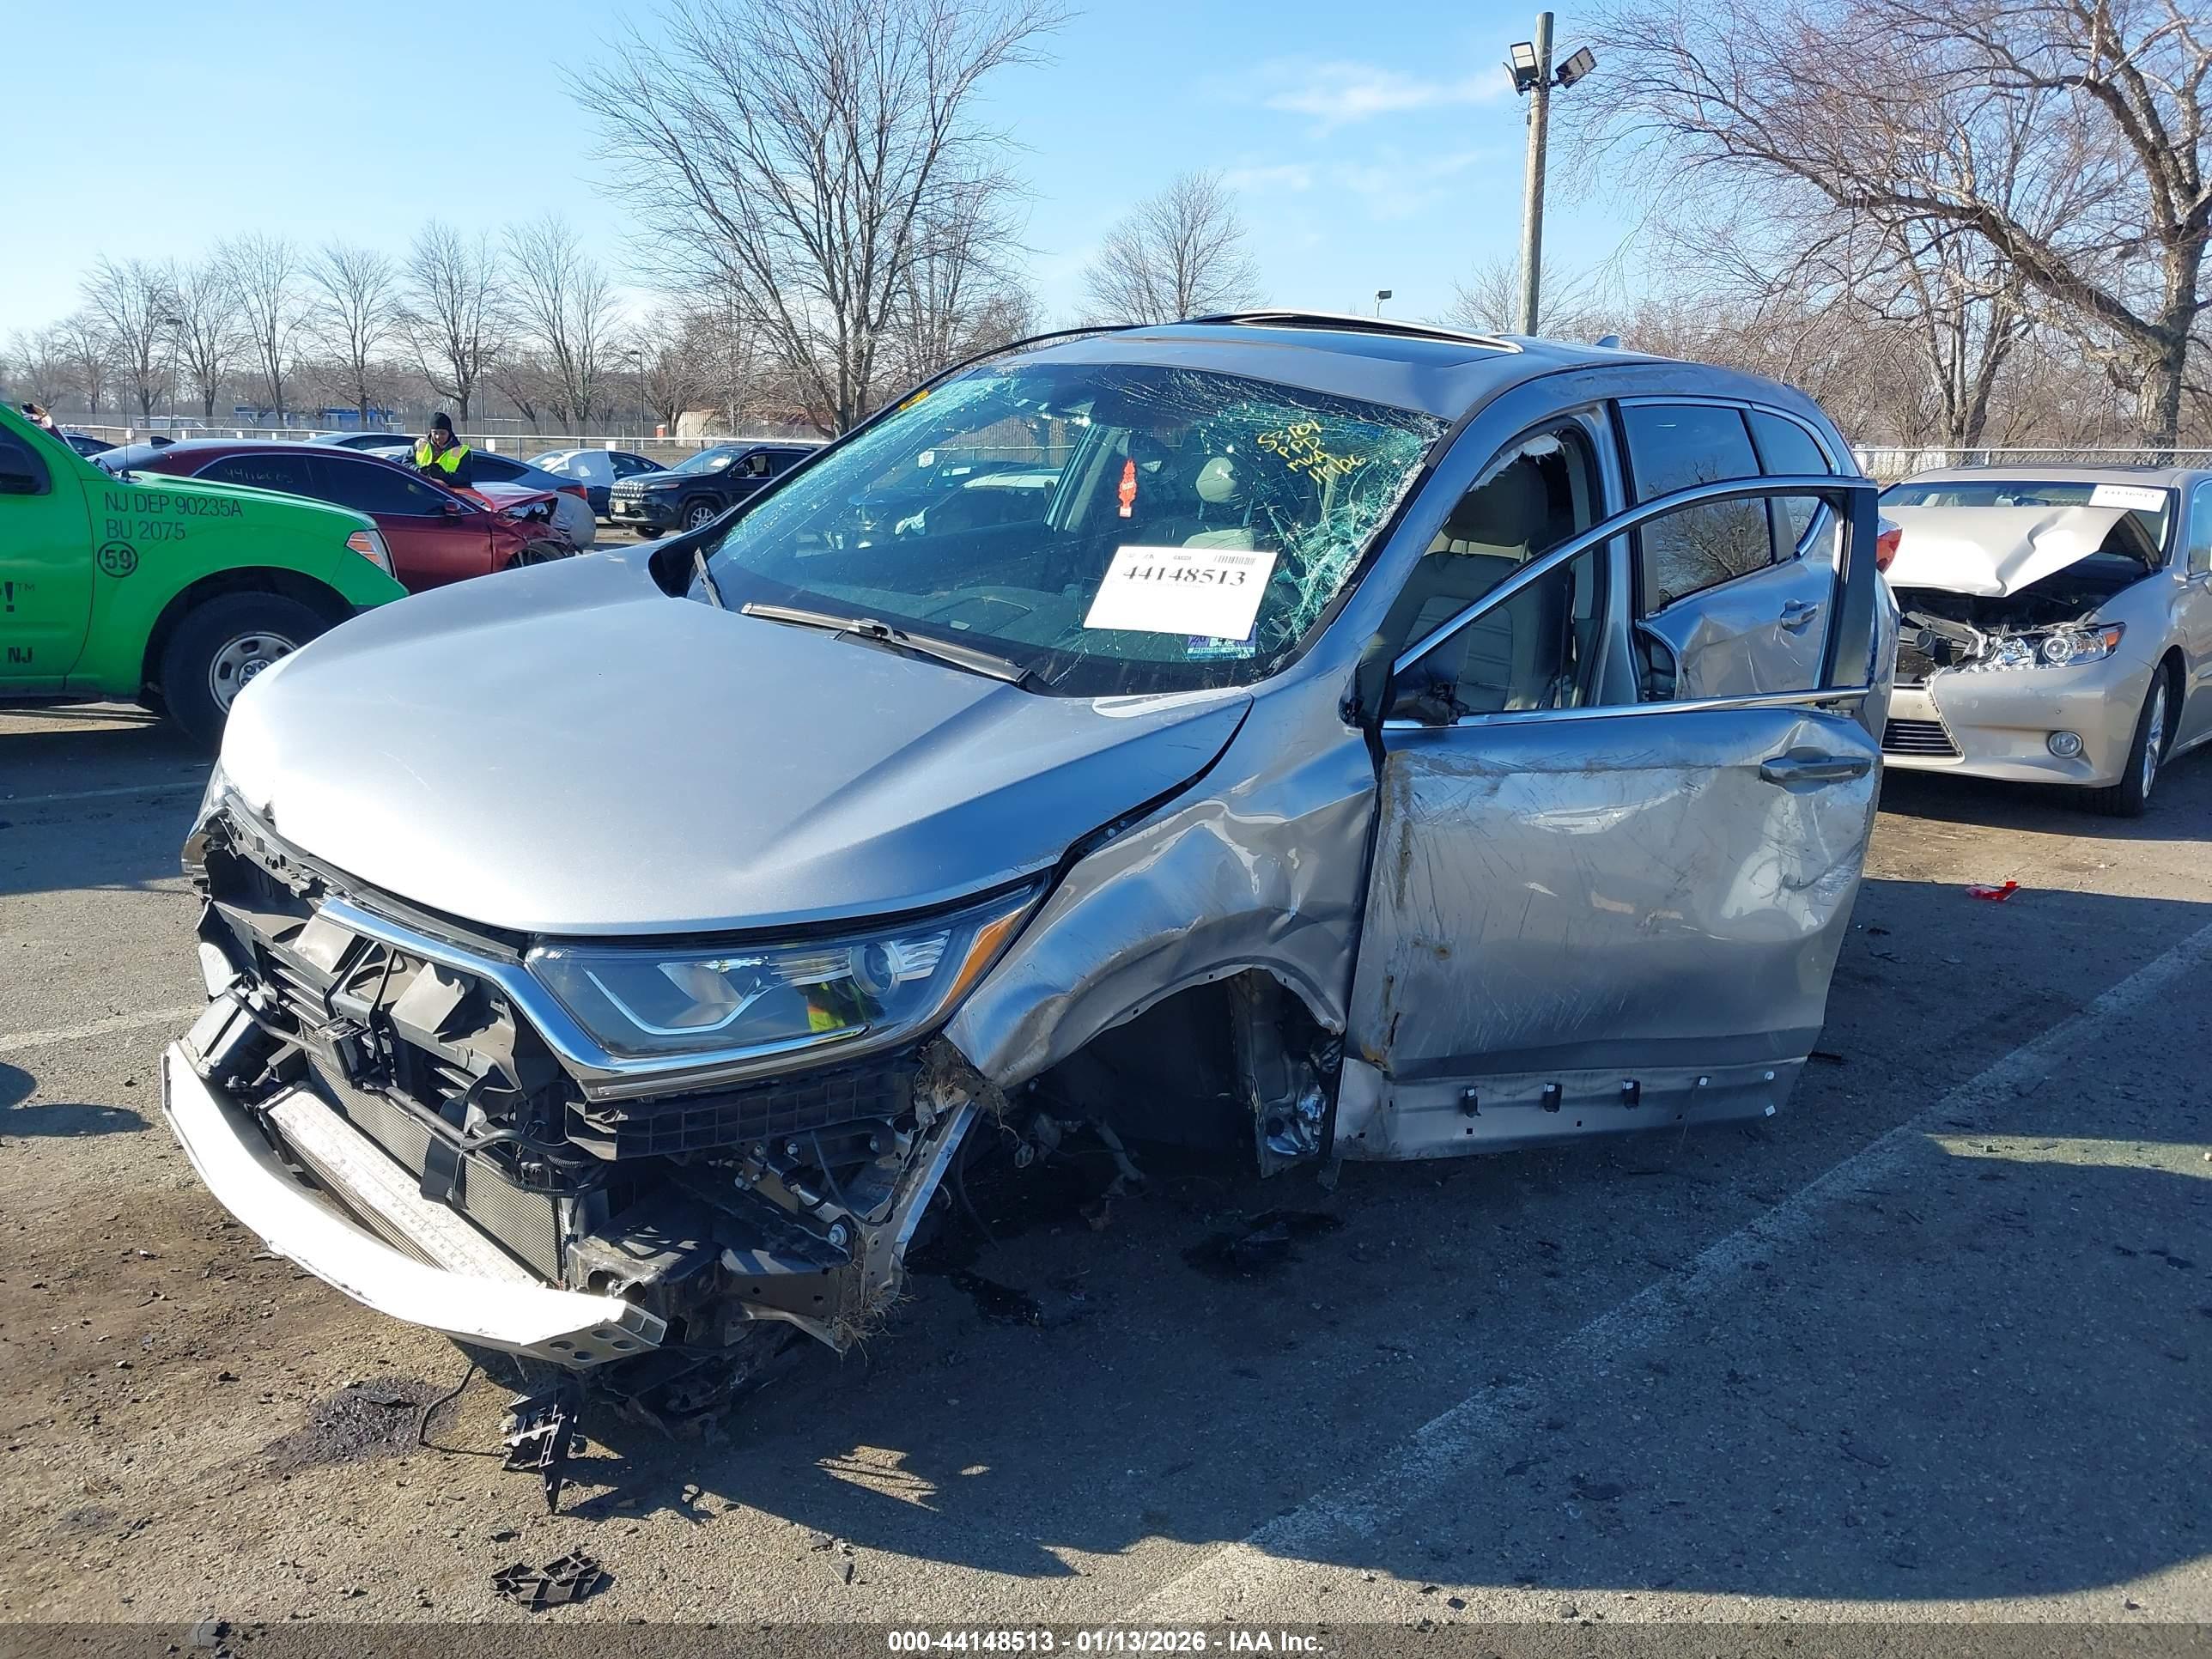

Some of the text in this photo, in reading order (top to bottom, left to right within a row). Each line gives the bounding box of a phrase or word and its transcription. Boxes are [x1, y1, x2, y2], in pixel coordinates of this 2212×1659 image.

[105, 492, 244, 517] NJ DEP 90235A
[106, 519, 186, 541] BU 2075
[105, 549, 132, 569] 59
[1122, 565, 1247, 586] 44148513
[8, 646, 33, 663] NJ
